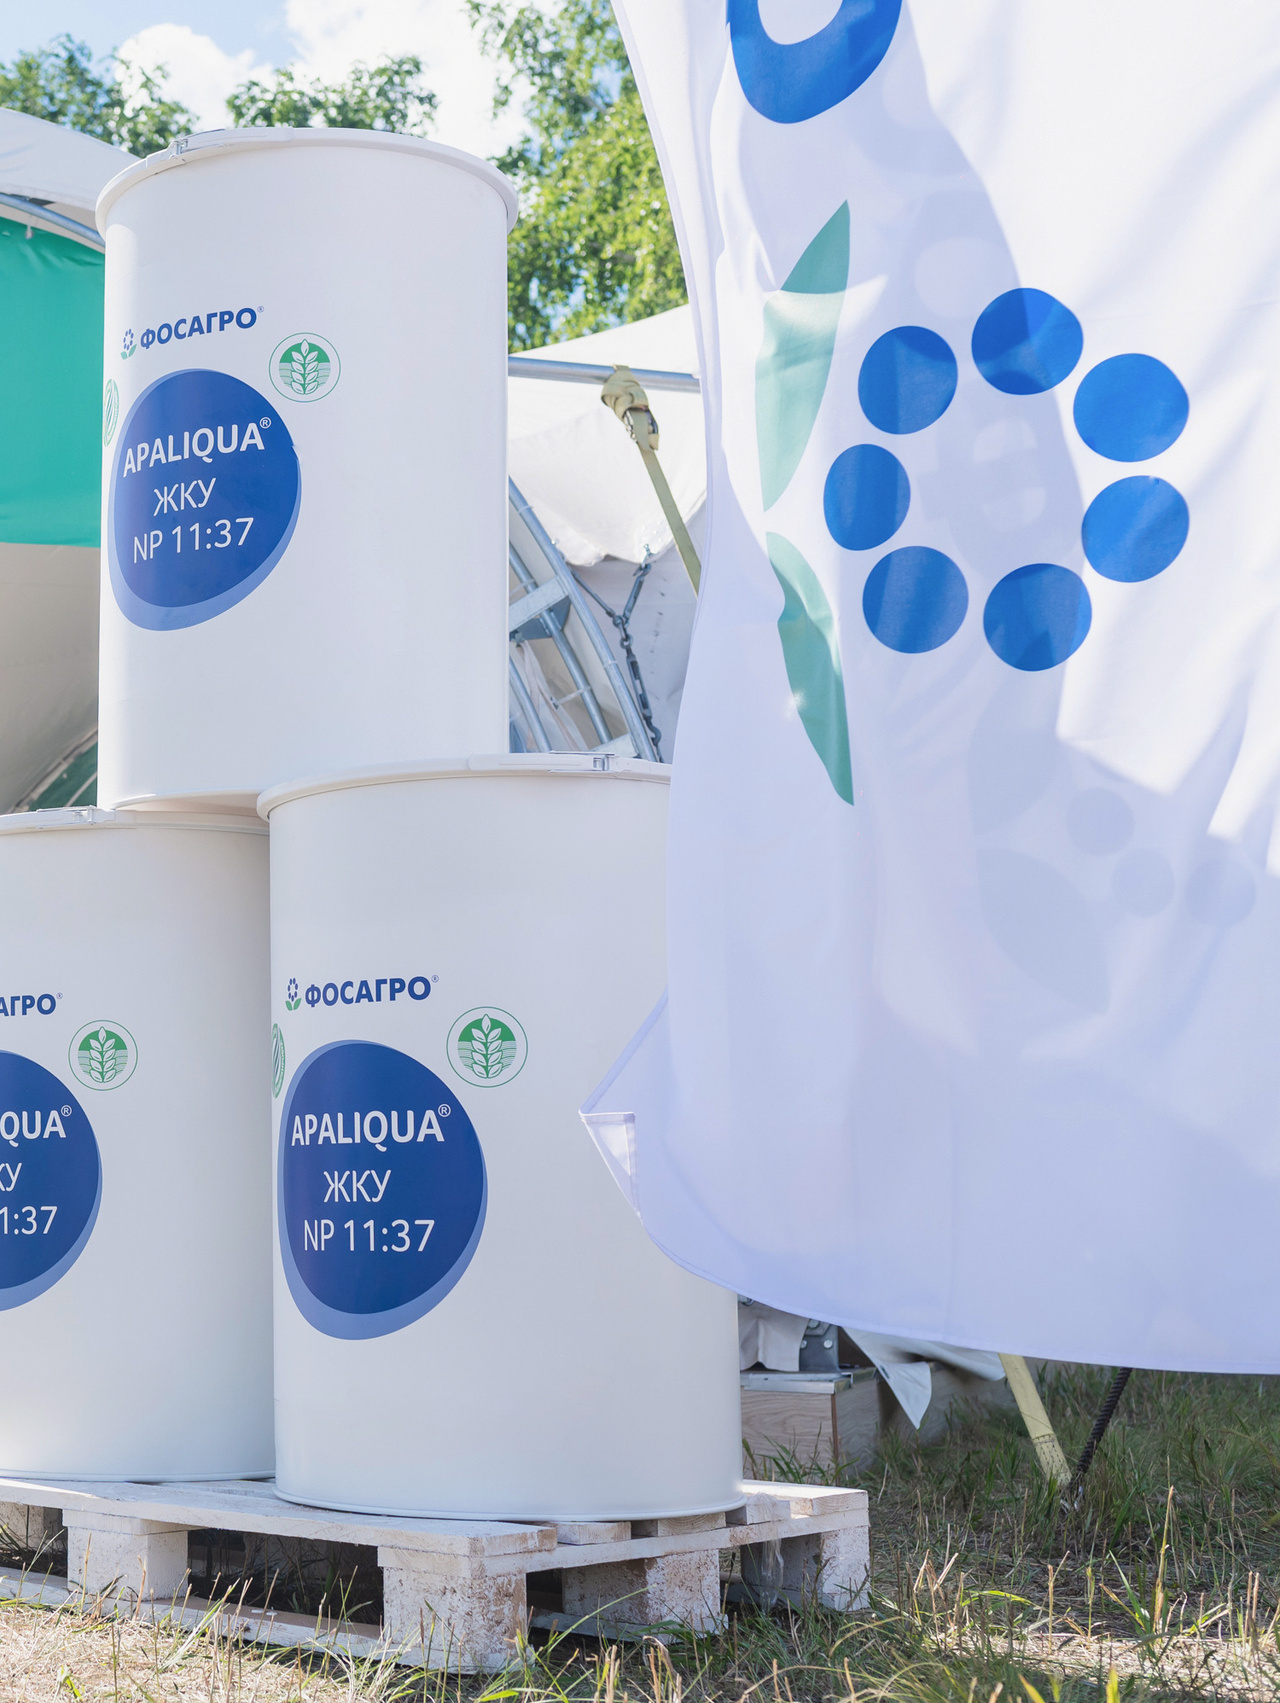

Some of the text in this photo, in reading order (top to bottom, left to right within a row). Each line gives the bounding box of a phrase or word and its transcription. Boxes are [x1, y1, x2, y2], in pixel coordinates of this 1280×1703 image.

[153, 477, 217, 517] ЖКУ
[133, 516, 255, 564] NP 11:37
[323, 1169, 392, 1203] ЖКУ
[304, 1218, 435, 1253] NP 11:37
